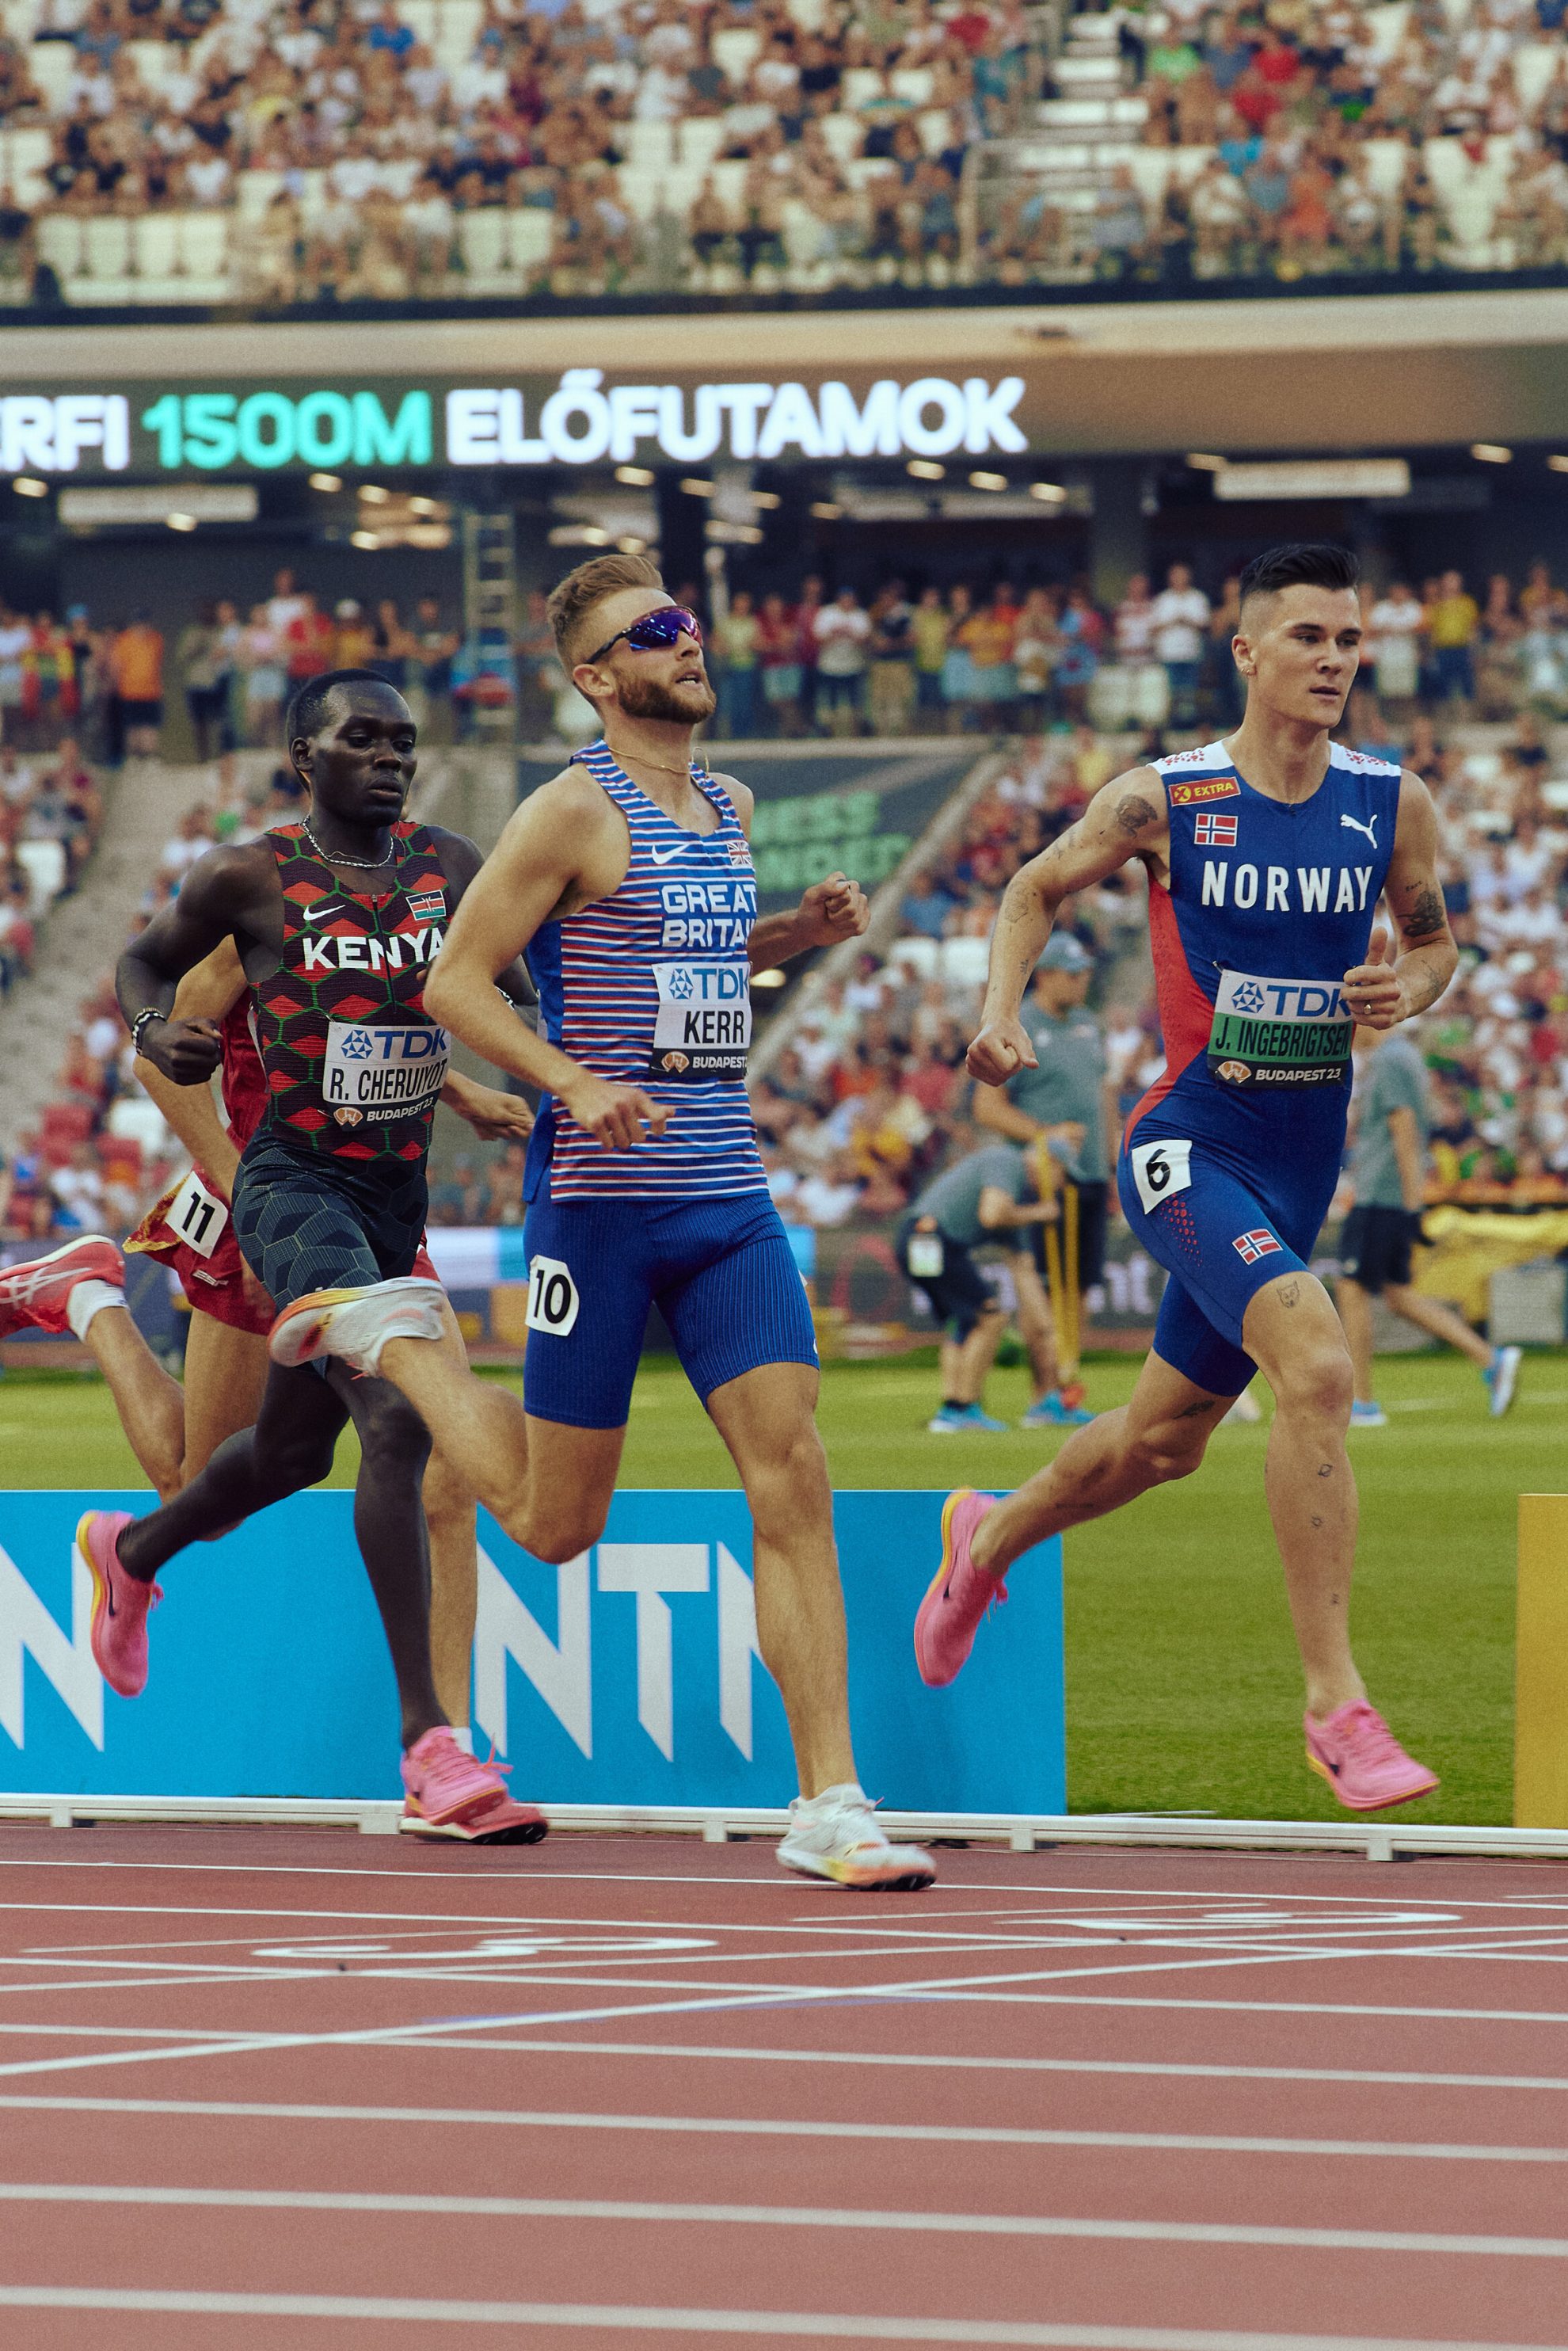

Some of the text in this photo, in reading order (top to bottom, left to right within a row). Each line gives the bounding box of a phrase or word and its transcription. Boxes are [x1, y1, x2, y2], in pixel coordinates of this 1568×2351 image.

[0, 368, 1029, 472] RFI 1500M ELŐFUTAMOK
[1193, 782, 1235, 797] EXTRA
[661, 884, 757, 913] GREAT
[1201, 860, 1373, 913] NORWAY
[303, 928, 444, 970] KENYA
[692, 968, 749, 1000] TDK
[1266, 985, 1352, 1018] TDK
[374, 1028, 447, 1060] TDK
[683, 1010, 744, 1044] KERR
[1216, 1016, 1350, 1057] J. INGEBRIGTSEN
[329, 1057, 448, 1101] R. CHERUIYOT
[1255, 1069, 1326, 1082] BUDAPEST
[366, 1101, 424, 1122] BUDAPEST
[1146, 1149, 1170, 1192] 6
[181, 1191, 215, 1244] 11
[534, 1268, 572, 1324] 10
